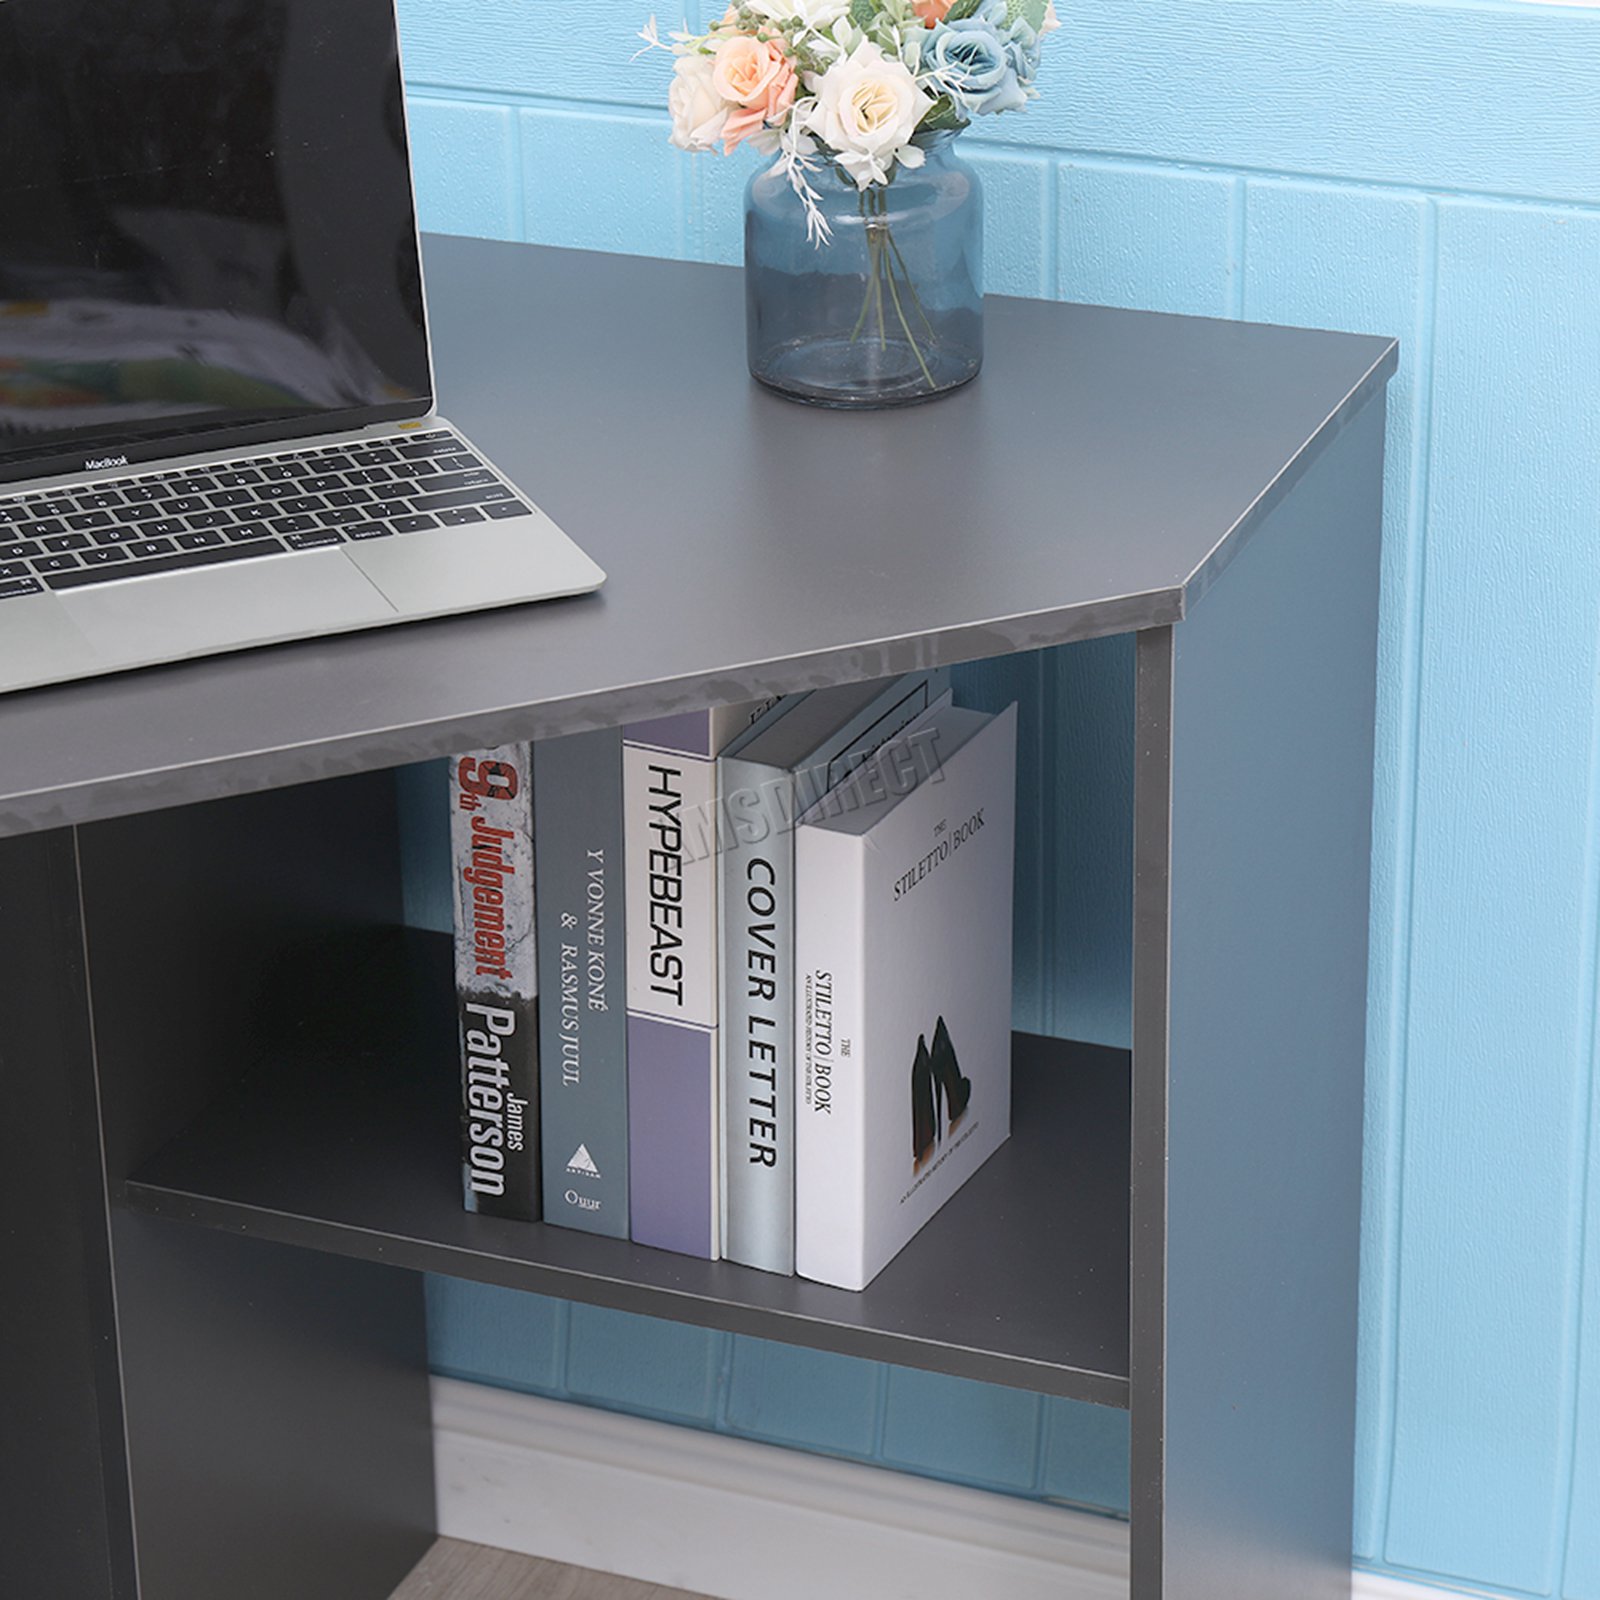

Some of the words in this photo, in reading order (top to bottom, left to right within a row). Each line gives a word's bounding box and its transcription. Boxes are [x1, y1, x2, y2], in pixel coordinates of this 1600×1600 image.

[85, 455, 128, 470] MacBook
[463, 815, 516, 980] Judgement
[561, 912, 579, 929] &
[649, 765, 683, 1006] HYPEBEAST
[747, 859, 776, 1001] COVER
[561, 943, 580, 1031] RASMUS
[588, 951, 608, 1012] KONÉ
[562, 1033, 580, 1087] JUUL
[840, 1038, 851, 1058] THE
[465, 1002, 516, 1197] Patterson
[506, 1093, 529, 1151] James
[749, 1015, 777, 1168] LETTER
